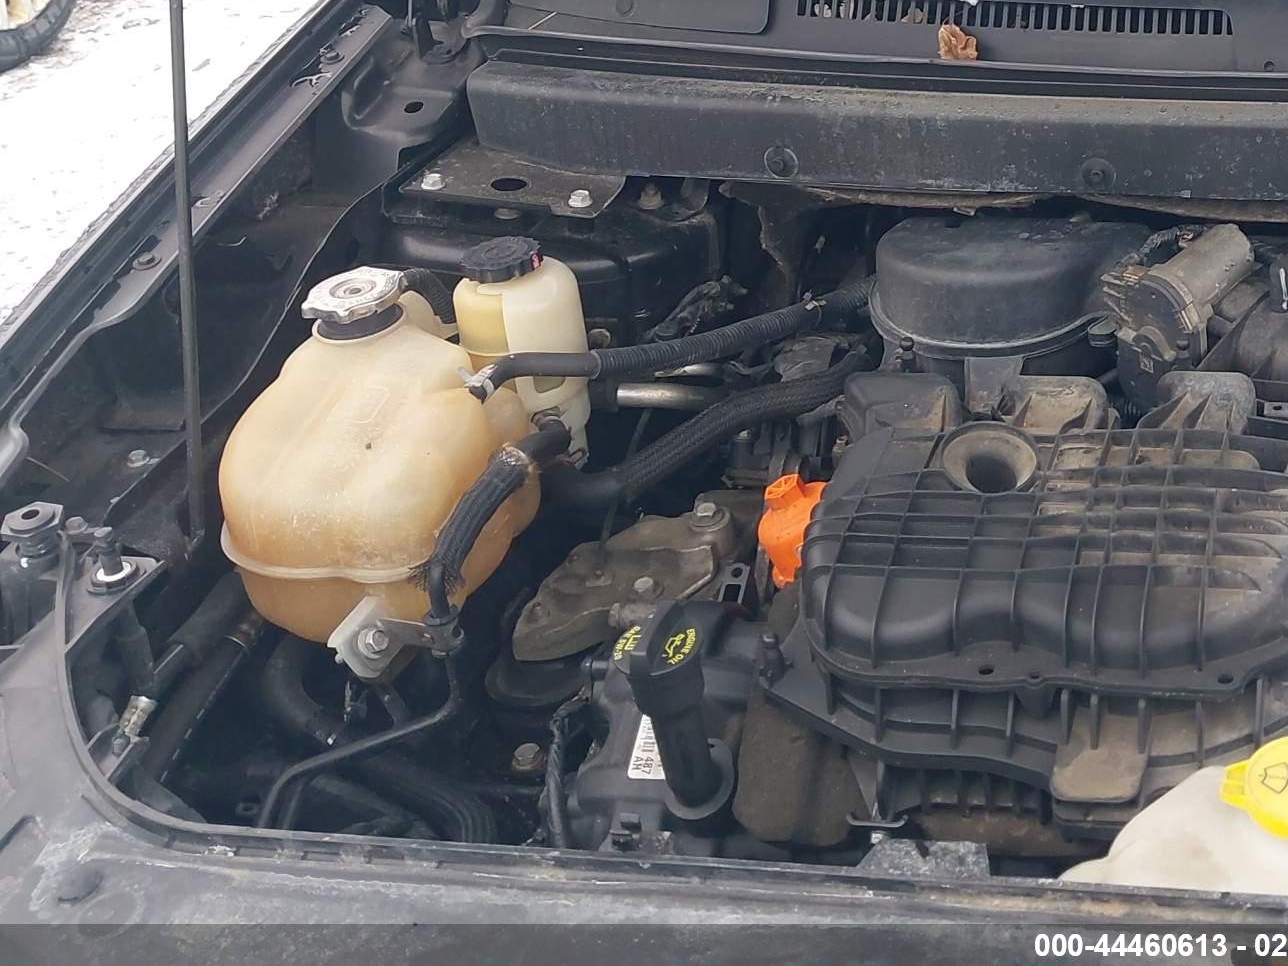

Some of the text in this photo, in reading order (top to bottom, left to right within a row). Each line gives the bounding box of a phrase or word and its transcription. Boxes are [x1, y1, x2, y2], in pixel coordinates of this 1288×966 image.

[666, 628, 697, 666] ENGINE OIL
[631, 755, 644, 771] AH
[641, 756, 655, 776] 487
